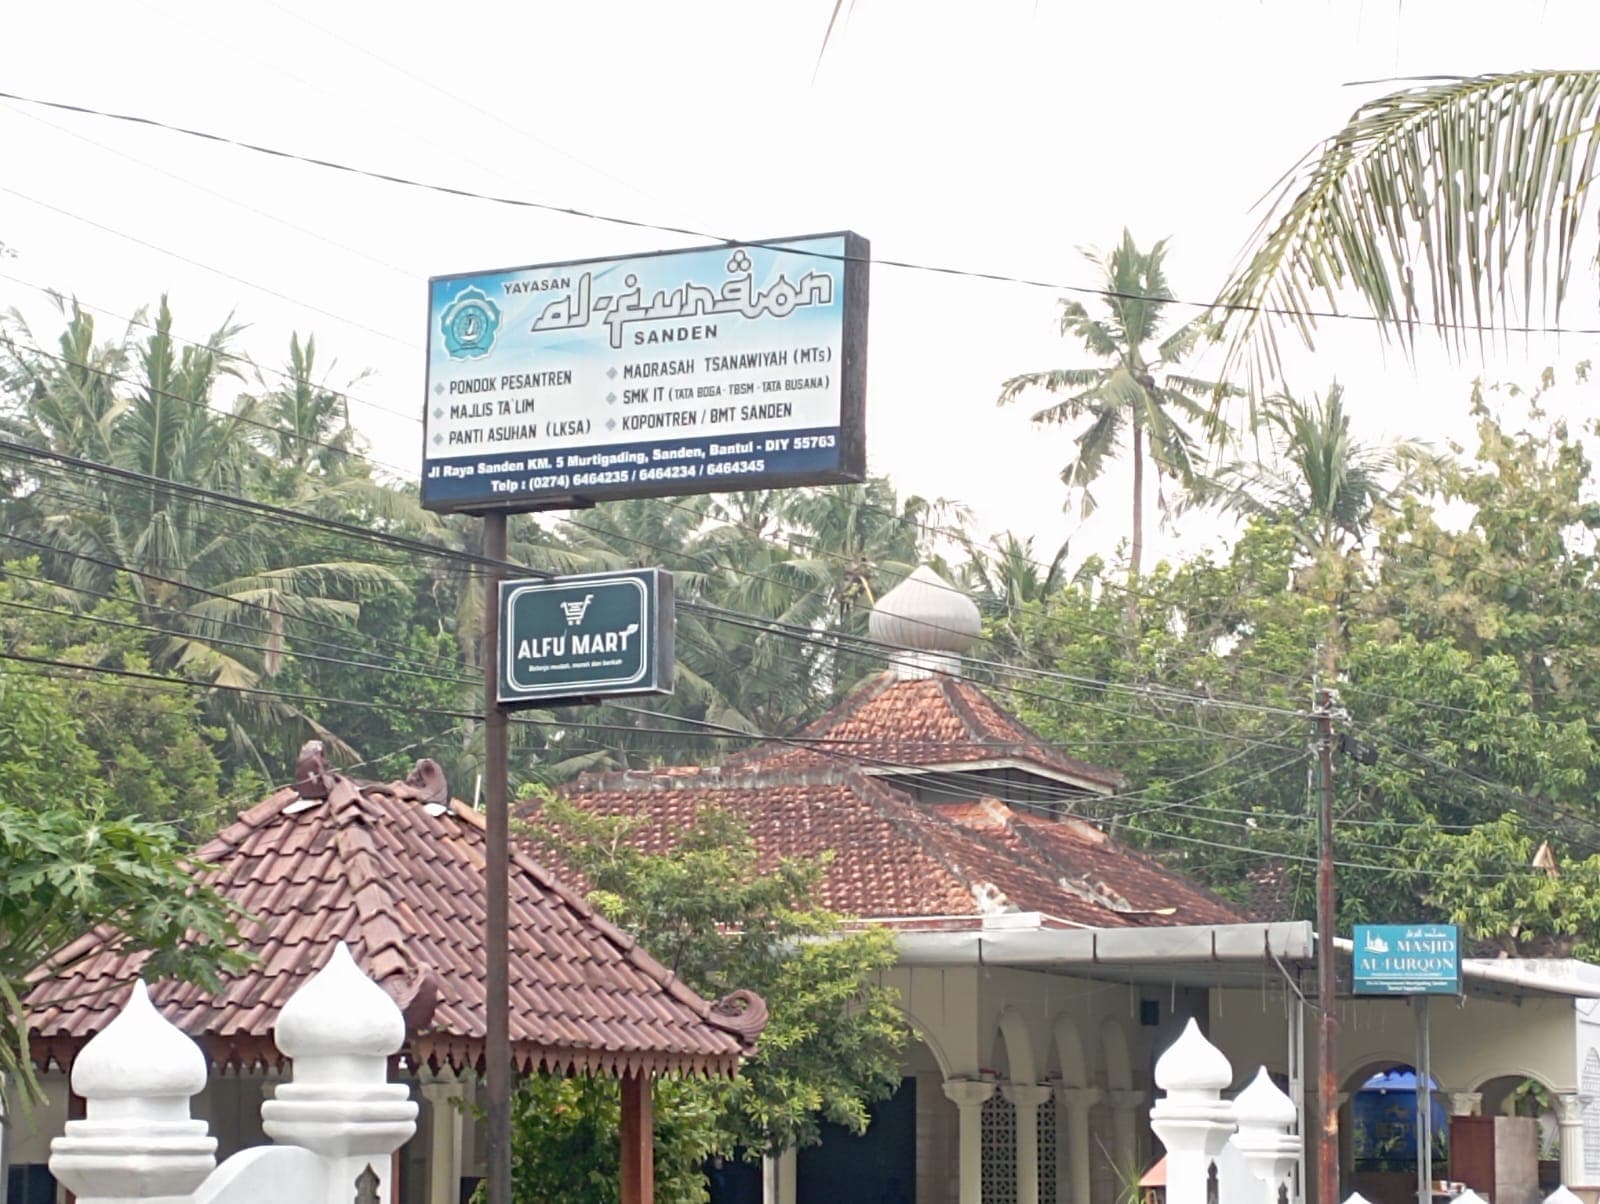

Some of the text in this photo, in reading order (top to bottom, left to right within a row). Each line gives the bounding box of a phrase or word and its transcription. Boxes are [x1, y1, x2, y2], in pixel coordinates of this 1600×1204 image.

[504, 277, 571, 295] YAYASAN
[634, 325, 718, 346] SANDEN
[624, 347, 832, 379] MADRASAH TSANAWIYAH (MTs)
[450, 370, 572, 395] PONDOK PESANTREN
[623, 390, 649, 404] SMK
[653, 387, 665, 402] IT
[697, 385, 722, 398] BOGA
[729, 382, 754, 395] TBSM
[762, 380, 781, 393] TATA
[784, 375, 830, 391] BUSANA)
[450, 402, 493, 419] MAJLIS
[622, 410, 697, 430] KOPONTREN
[710, 407, 736, 423] BMT
[741, 402, 792, 421] SANDEN
[449, 419, 591, 445] PANTI ASUHAN (LKSA)
[443, 464, 474, 478] Raya
[477, 460, 524, 475] Sanden
[528, 457, 552, 470] KM.
[556, 456, 564, 467] 5
[567, 451, 649, 467] Murtigading,
[652, 447, 706, 461] Sanden,
[709, 441, 753, 456] Bantul
[765, 438, 789, 451] DIY
[793, 435, 836, 449] 55763
[491, 478, 519, 494] Telp
[529, 476, 570, 492] (0274)
[573, 469, 628, 486] 6464235
[639, 465, 696, 480] 6464234
[706, 459, 764, 476] 6464345
[517, 628, 634, 659] ALFU MART
[1397, 940, 1455, 954] MASJID
